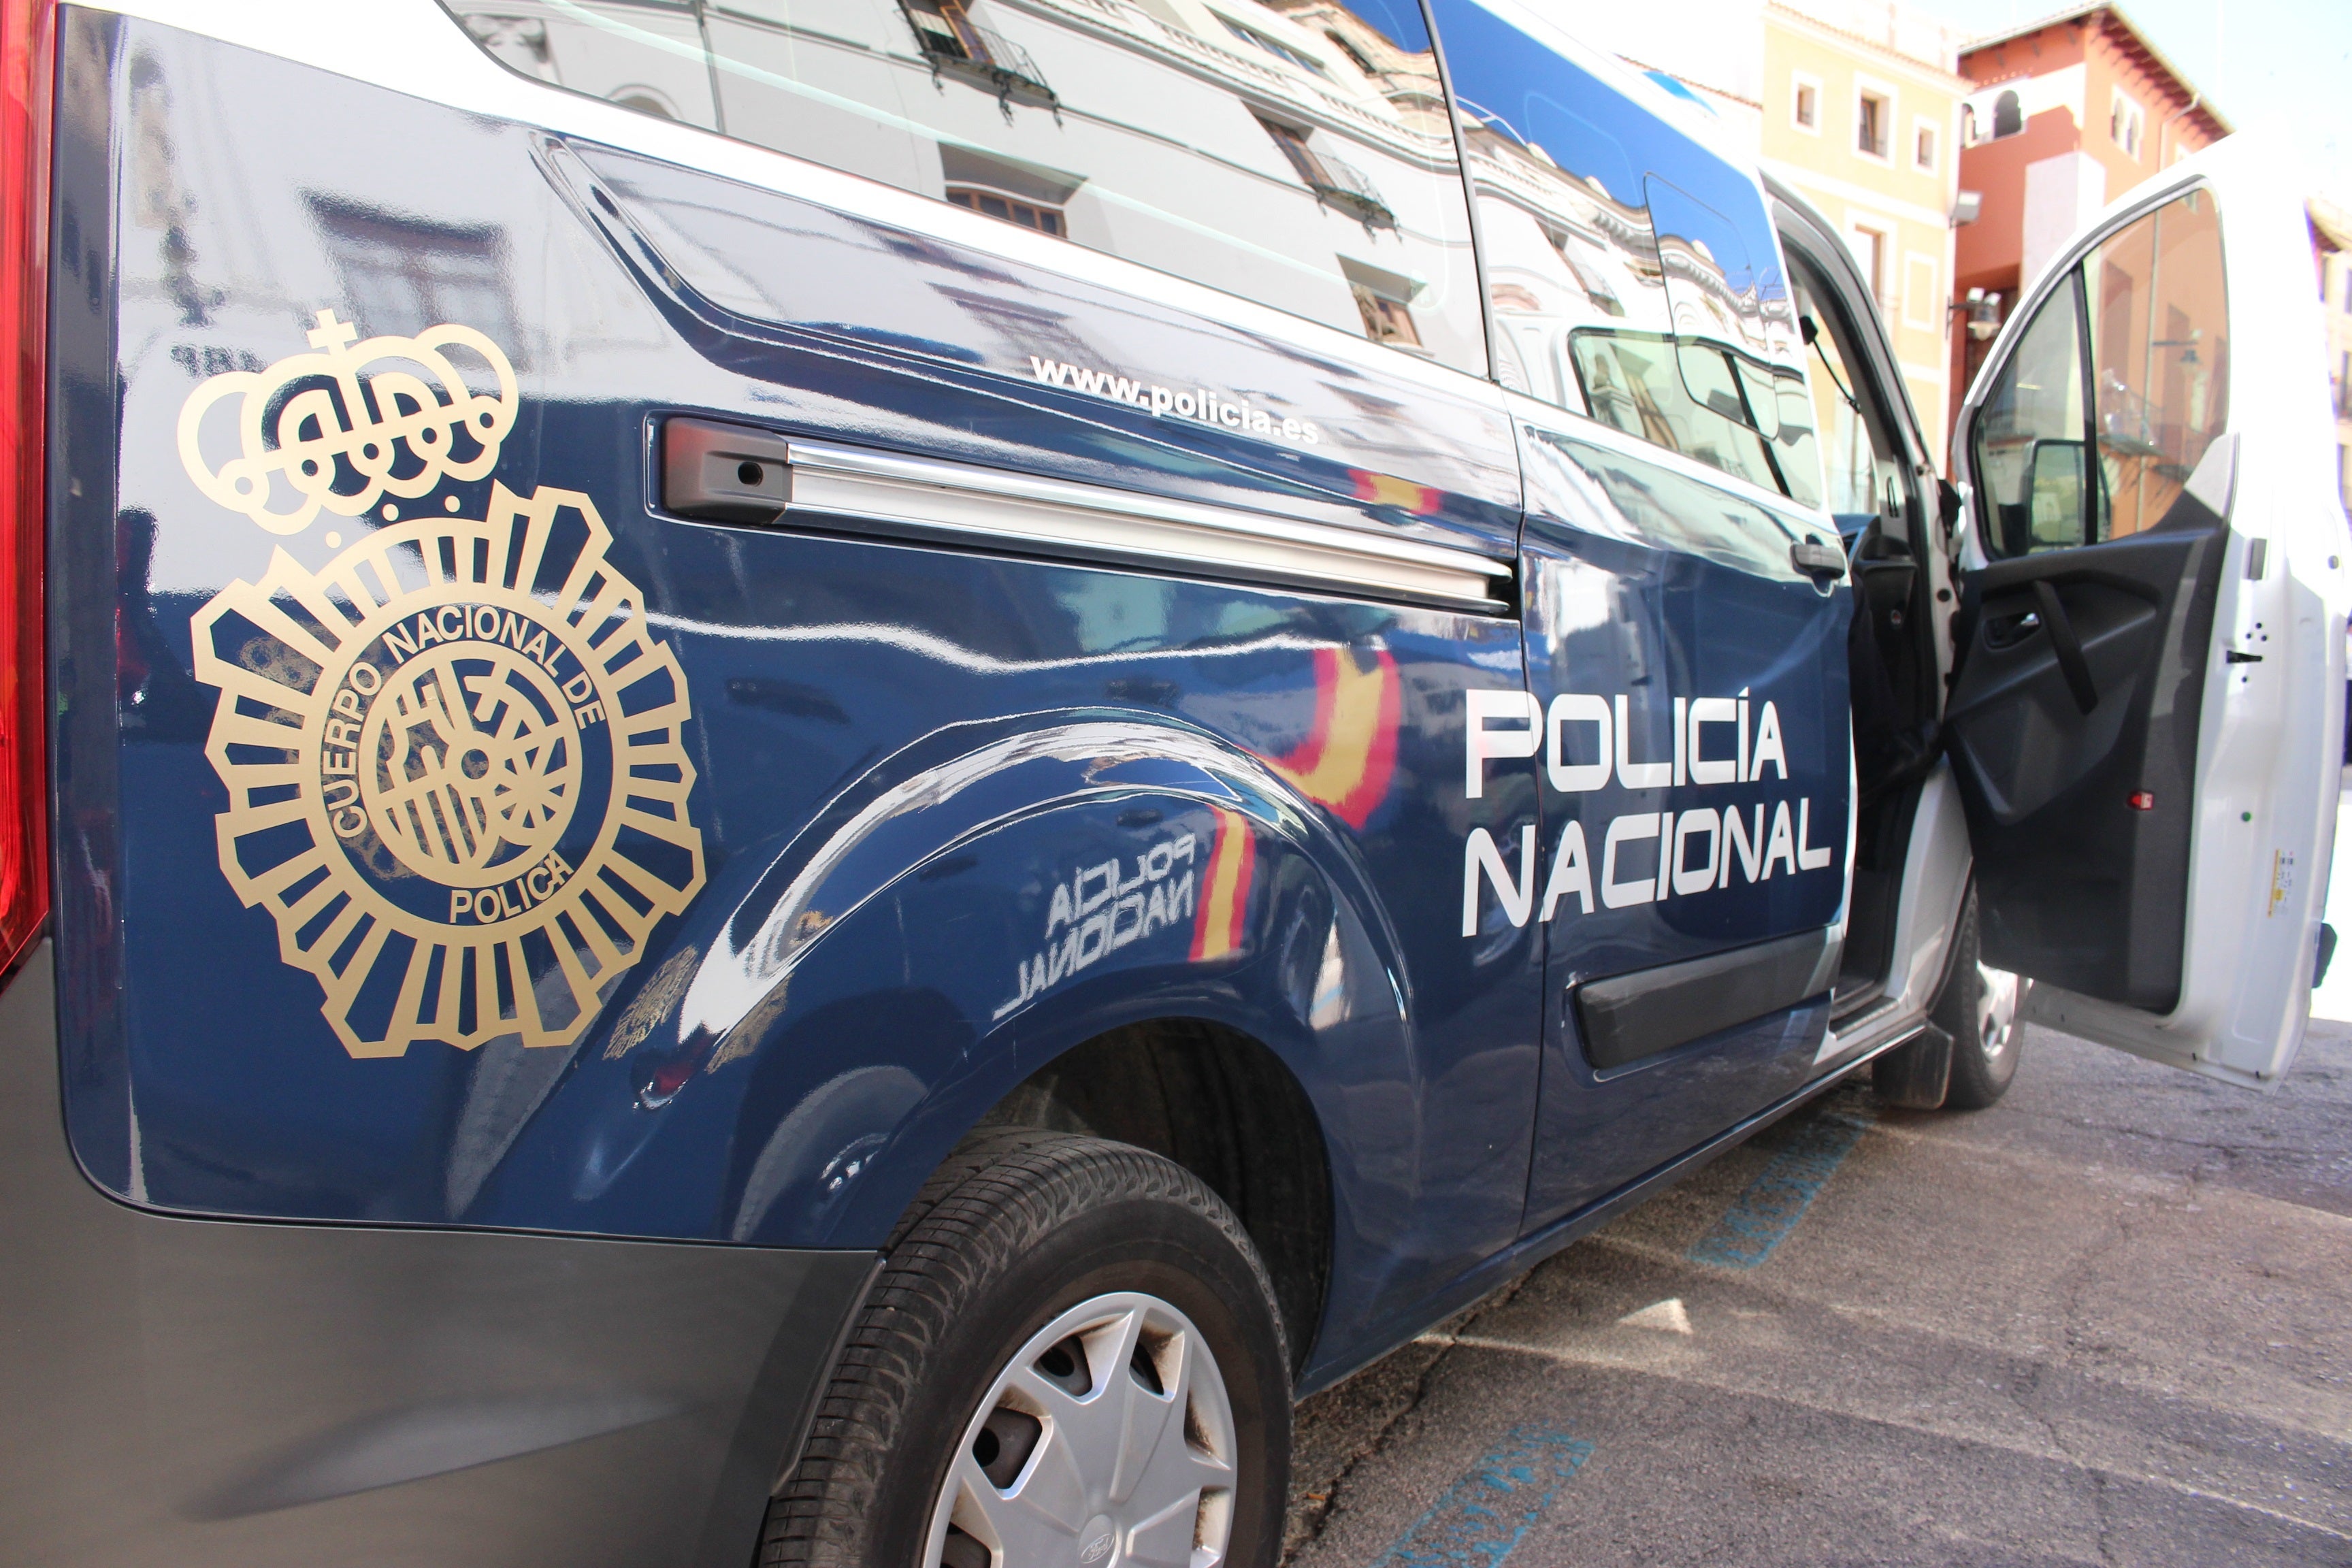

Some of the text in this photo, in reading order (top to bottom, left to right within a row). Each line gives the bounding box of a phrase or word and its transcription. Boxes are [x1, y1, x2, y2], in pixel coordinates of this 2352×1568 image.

[1030, 355, 1319, 444] www.policia.es
[322, 604, 606, 838] CUERPO NACIONAL DE
[1466, 687, 1788, 799] POLICÍA
[1462, 798, 1831, 938] NACIONAL
